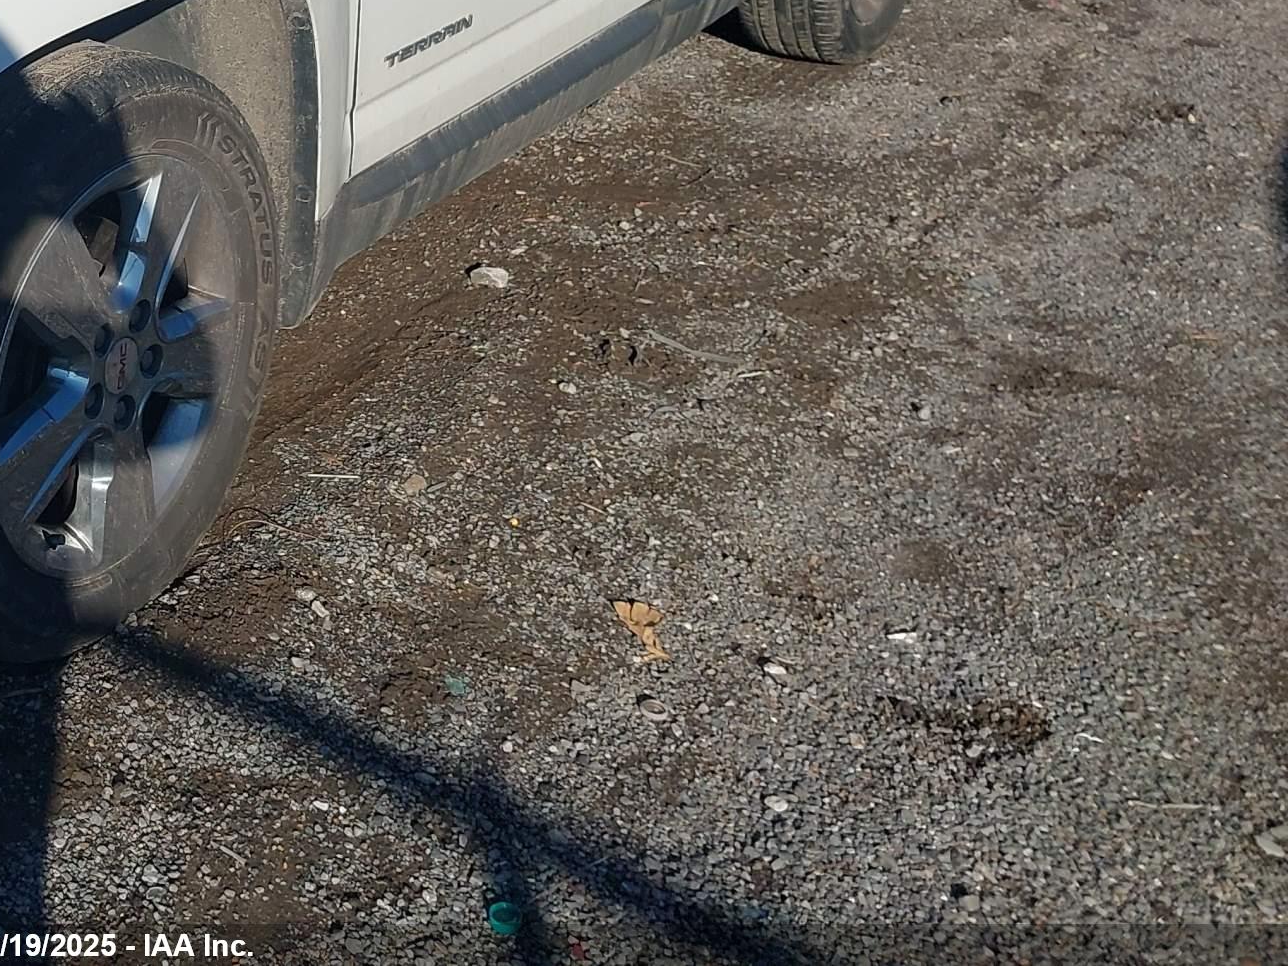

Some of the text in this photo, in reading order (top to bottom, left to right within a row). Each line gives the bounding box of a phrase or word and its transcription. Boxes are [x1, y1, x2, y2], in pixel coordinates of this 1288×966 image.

[383, 13, 474, 68] TERRAIN
[218, 135, 273, 285] STRATUS
[116, 341, 129, 391] GMC
